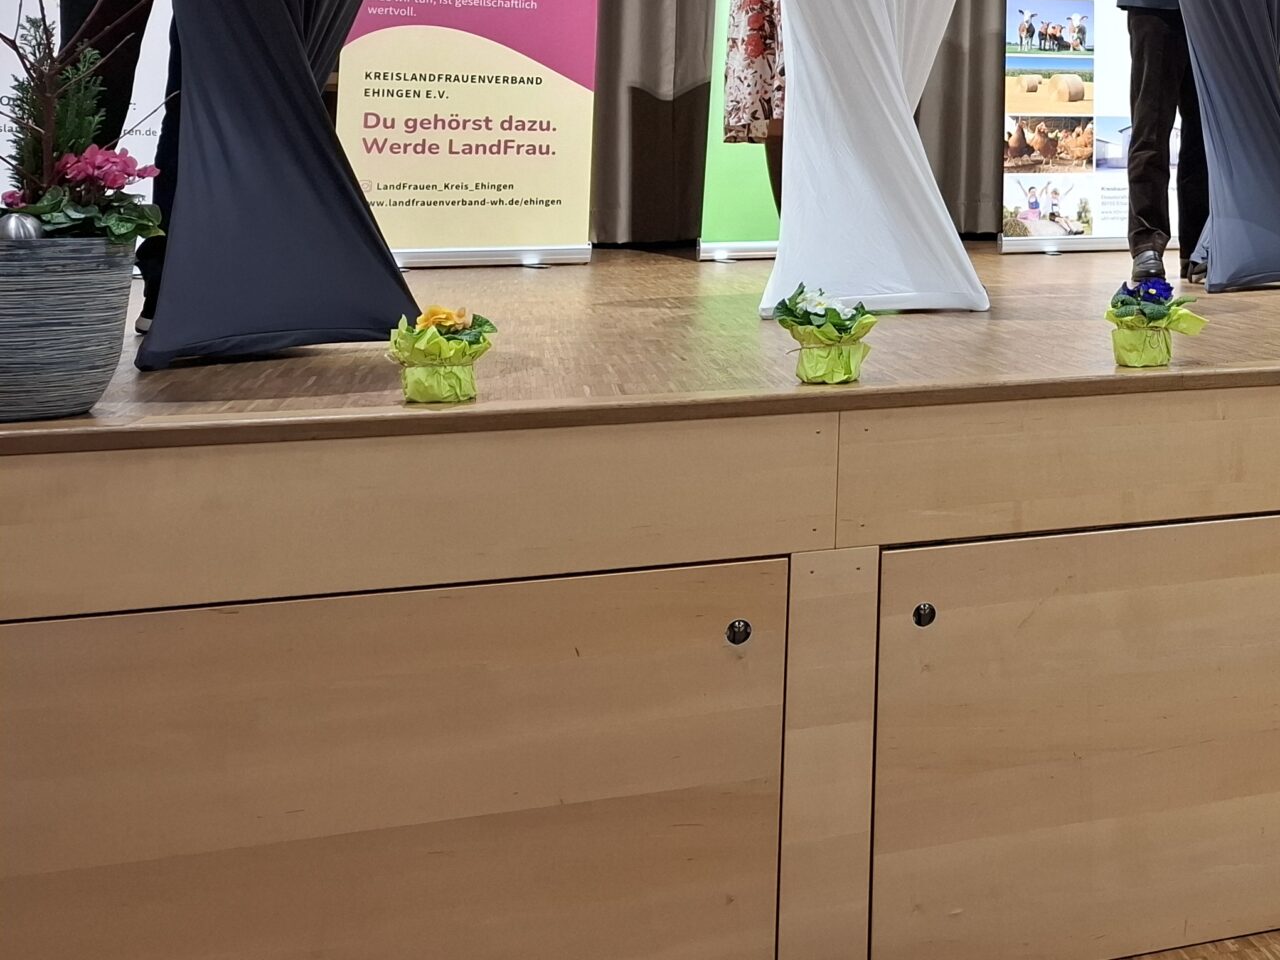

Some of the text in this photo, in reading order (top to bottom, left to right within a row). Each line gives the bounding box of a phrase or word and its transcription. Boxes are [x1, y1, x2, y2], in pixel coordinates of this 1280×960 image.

[367, 6, 417, 17] wertvoll.
[364, 71, 543, 85] KREISLANDFRAUENVERBAND
[364, 88, 450, 100] EHINGEN E.V.
[363, 112, 557, 133] Du gehörst dazu.
[362, 137, 557, 156] Werde LandFrau.
[376, 181, 515, 192] LandFrauen_Kreis_Ehingen
[367, 197, 562, 208] ww.landfrauenverband-wh.de/ehingen
